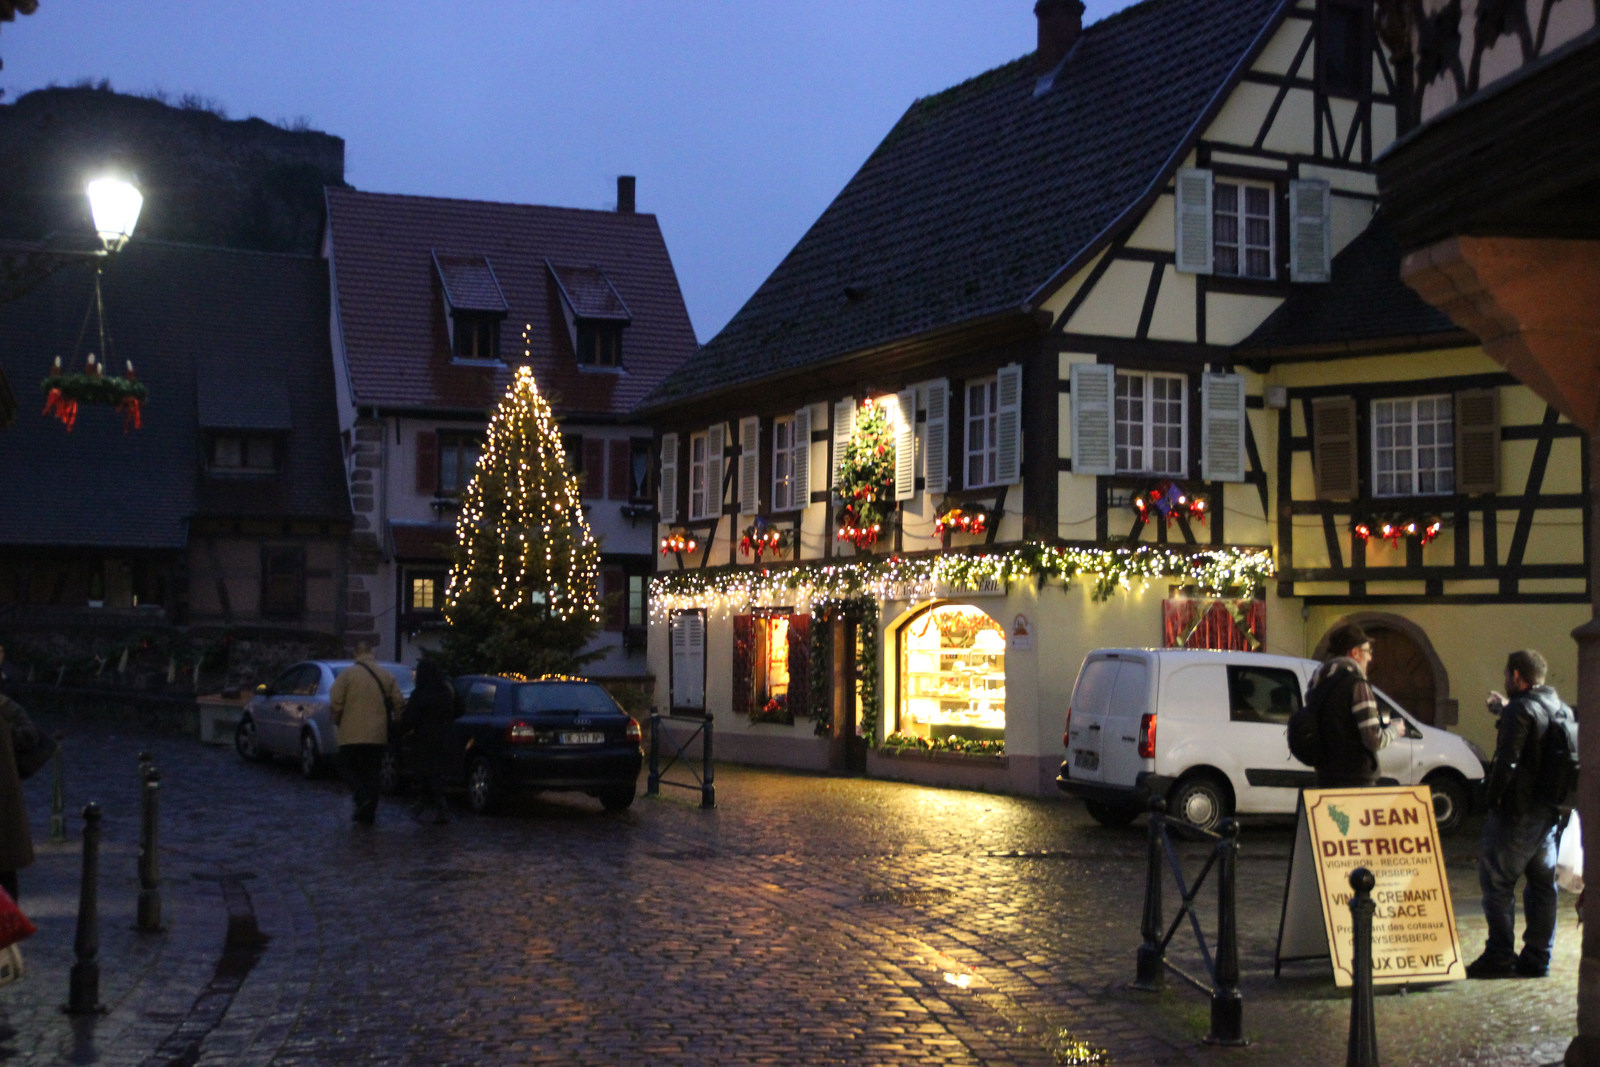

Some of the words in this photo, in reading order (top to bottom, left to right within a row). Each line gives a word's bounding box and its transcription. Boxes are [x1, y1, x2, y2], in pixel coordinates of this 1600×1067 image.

[1359, 808, 1419, 826] JEAN
[1321, 837, 1432, 857] DIETRICH
[1325, 859, 1373, 869] VIGNERON
[1332, 892, 1353, 906] VIN
[1377, 889, 1438, 904] CREMANT
[1388, 922, 1405, 932] des
[1407, 920, 1444, 931] coteaux
[1396, 956, 1416, 969] DE
[1419, 954, 1446, 968] VIE
